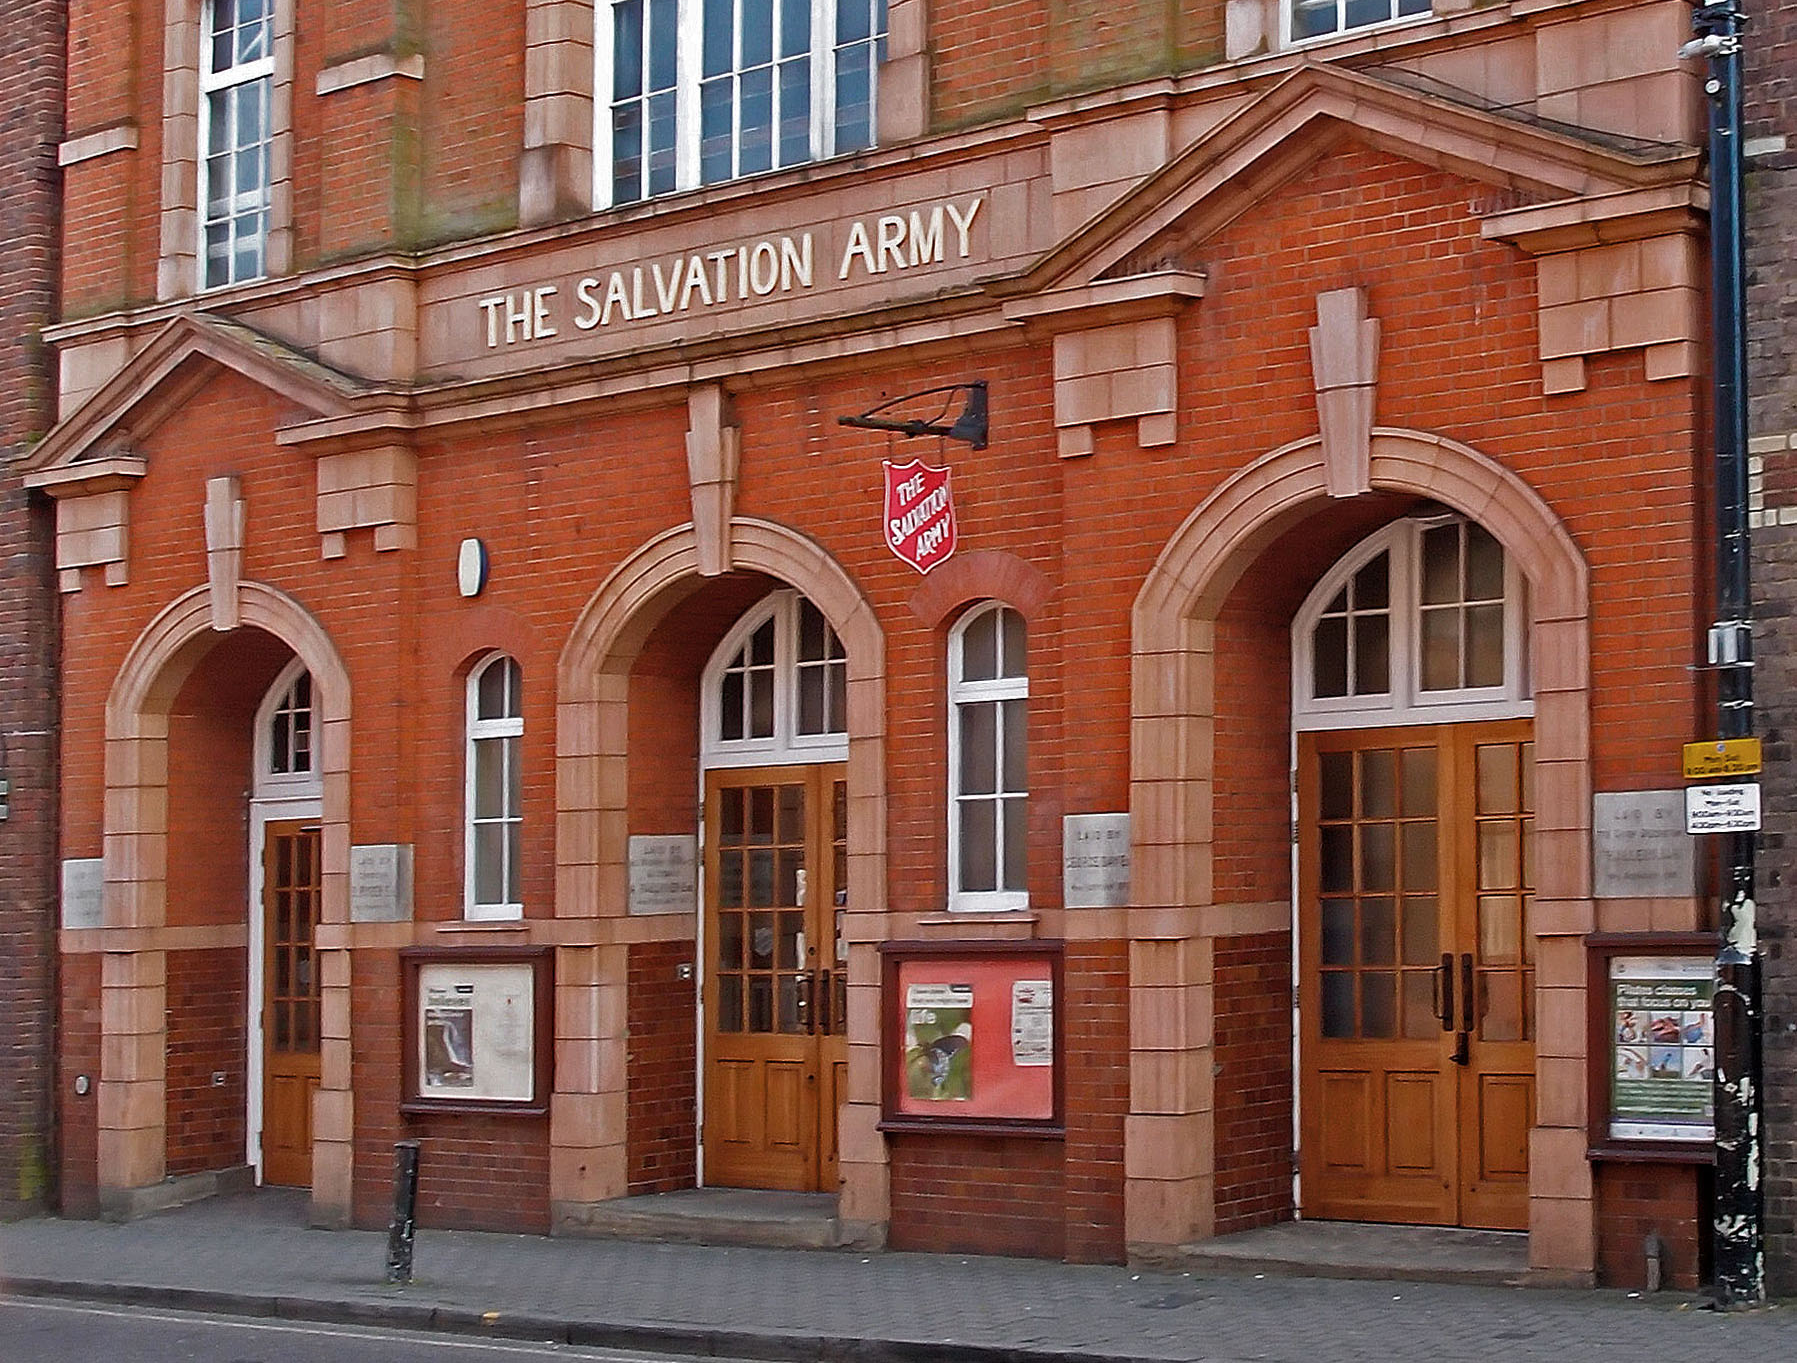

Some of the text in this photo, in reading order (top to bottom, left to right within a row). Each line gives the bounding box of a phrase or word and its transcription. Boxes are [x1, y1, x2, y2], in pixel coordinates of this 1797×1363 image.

[479, 197, 983, 347] THE SALVATION ARMY
[896, 472, 926, 507] THE
[915, 513, 951, 562] ARMY
[1640, 996, 1672, 1007] focus
[1672, 998, 1689, 1007] on
[1655, 984, 1697, 996] classes
